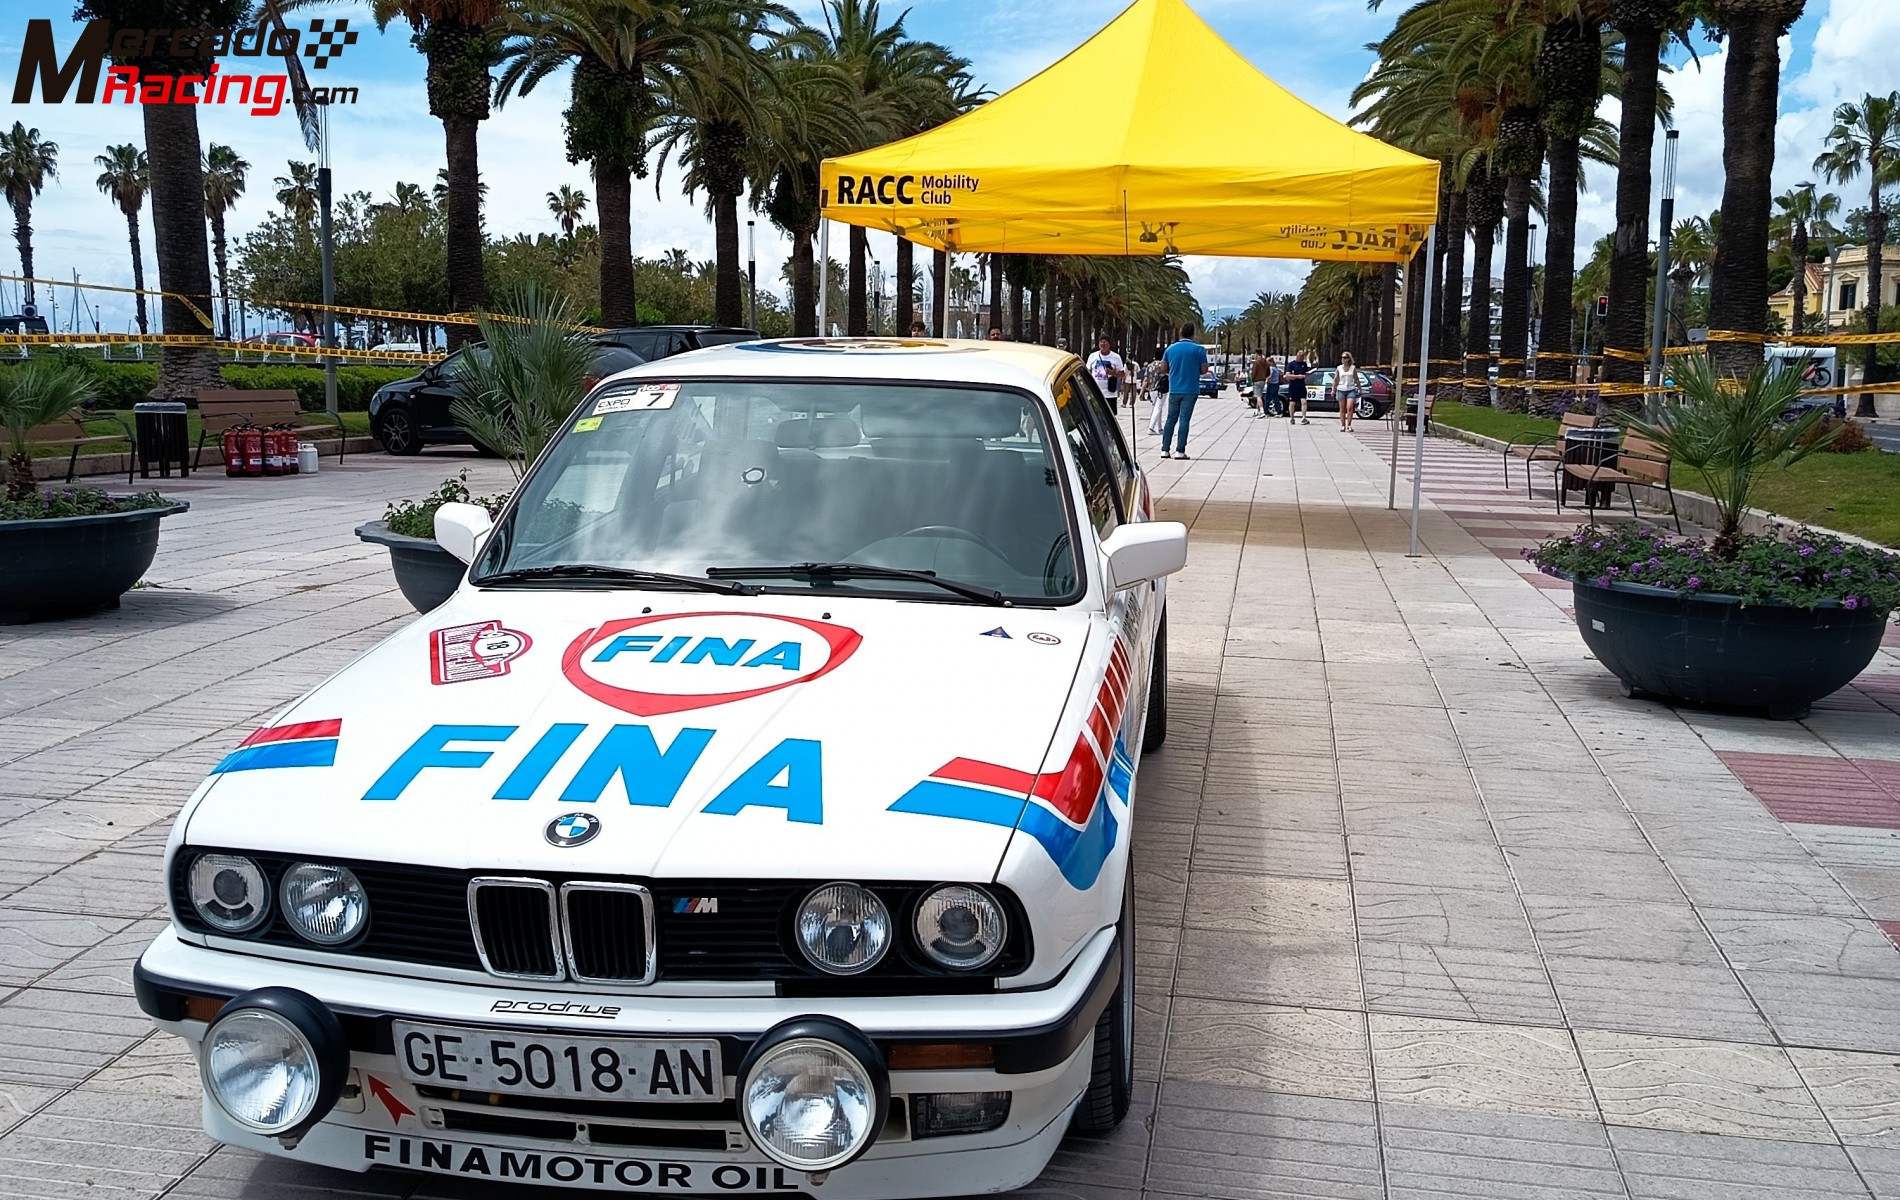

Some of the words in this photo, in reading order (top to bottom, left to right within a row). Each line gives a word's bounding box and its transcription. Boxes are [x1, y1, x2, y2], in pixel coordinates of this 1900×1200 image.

[837, 175, 915, 205] RACC
[921, 174, 980, 192] Mobility
[921, 191, 953, 204] Club
[598, 398, 631, 408] EXPO
[646, 392, 665, 407] 7
[592, 635, 802, 671] FINA
[360, 723, 824, 826] FINA
[557, 812, 598, 824] BMW
[693, 897, 718, 913] M
[490, 1000, 622, 1016] prodrive
[711, 1164, 800, 1190] OIL
